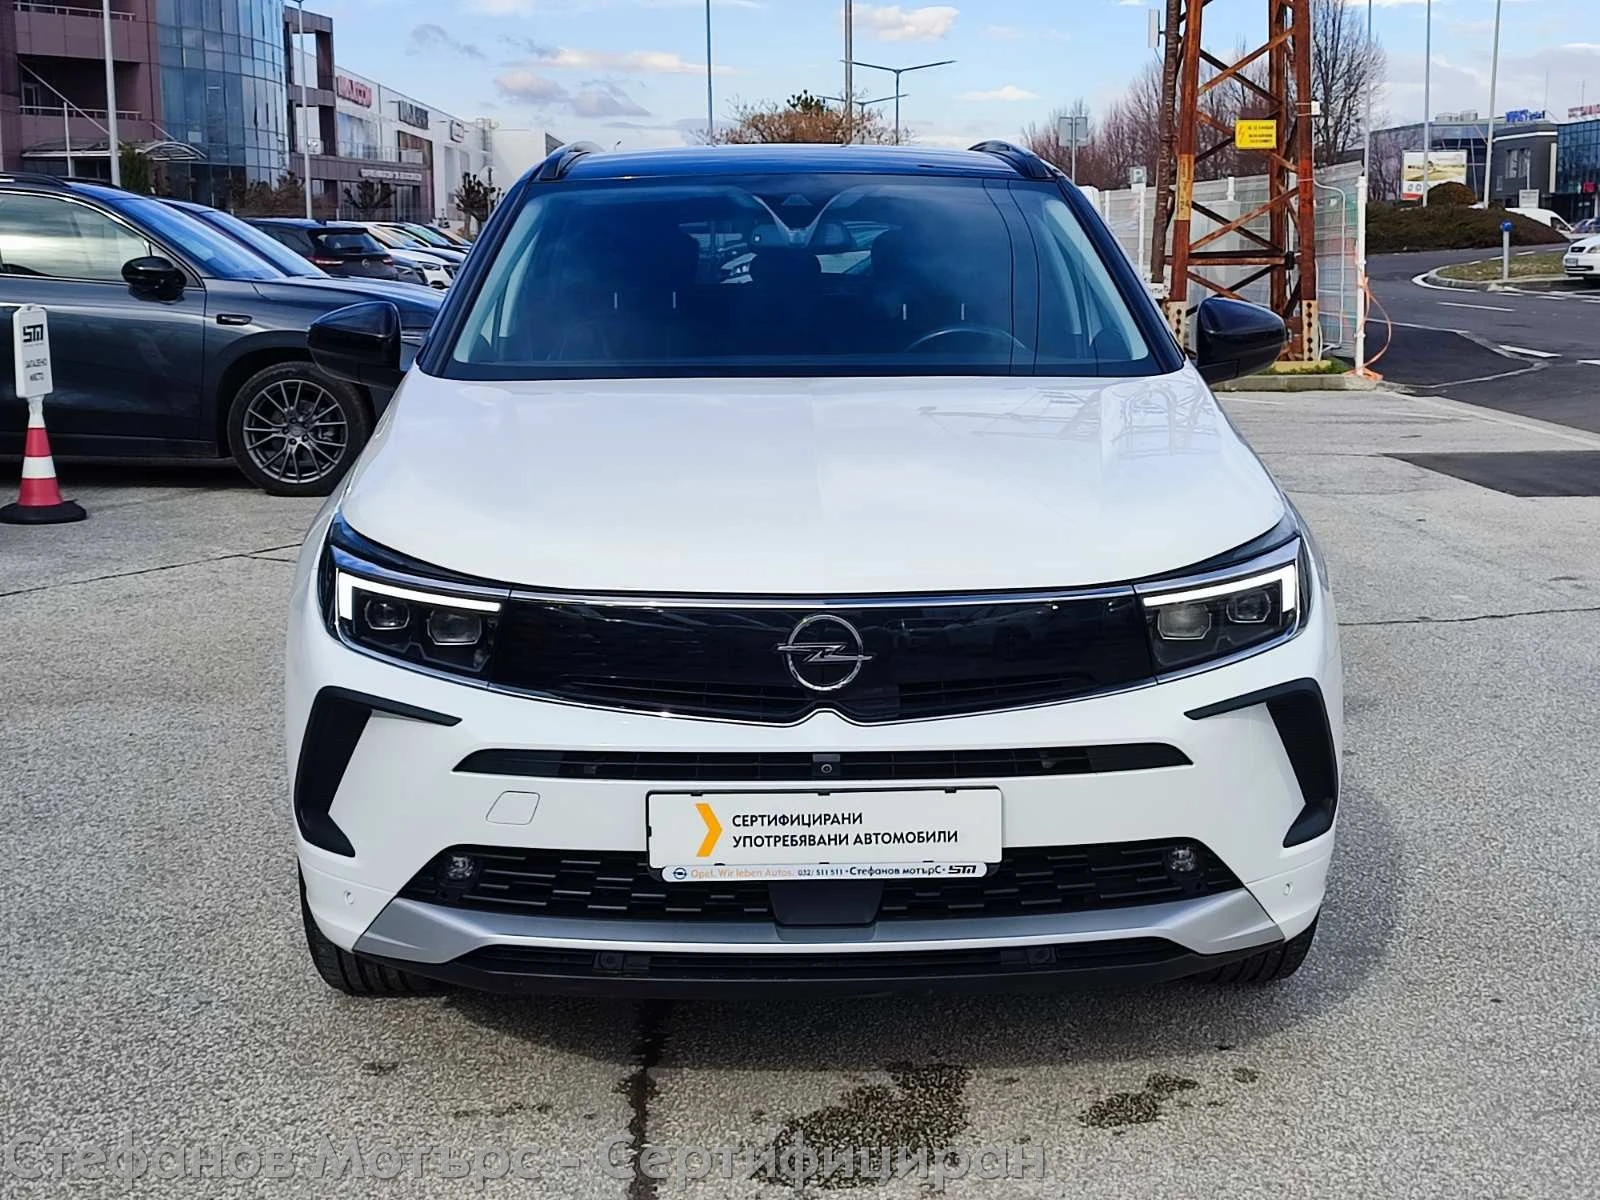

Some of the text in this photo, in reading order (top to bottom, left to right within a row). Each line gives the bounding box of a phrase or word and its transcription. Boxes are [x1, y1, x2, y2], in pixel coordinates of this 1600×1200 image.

[732, 812, 863, 828] СЕРТИФИЦИРАНИ
[732, 830, 959, 848] УПОТРЕБЯВАНИ АВТОМОБИЛИ
[719, 868, 733, 878] Wir
[736, 867, 763, 878] leben
